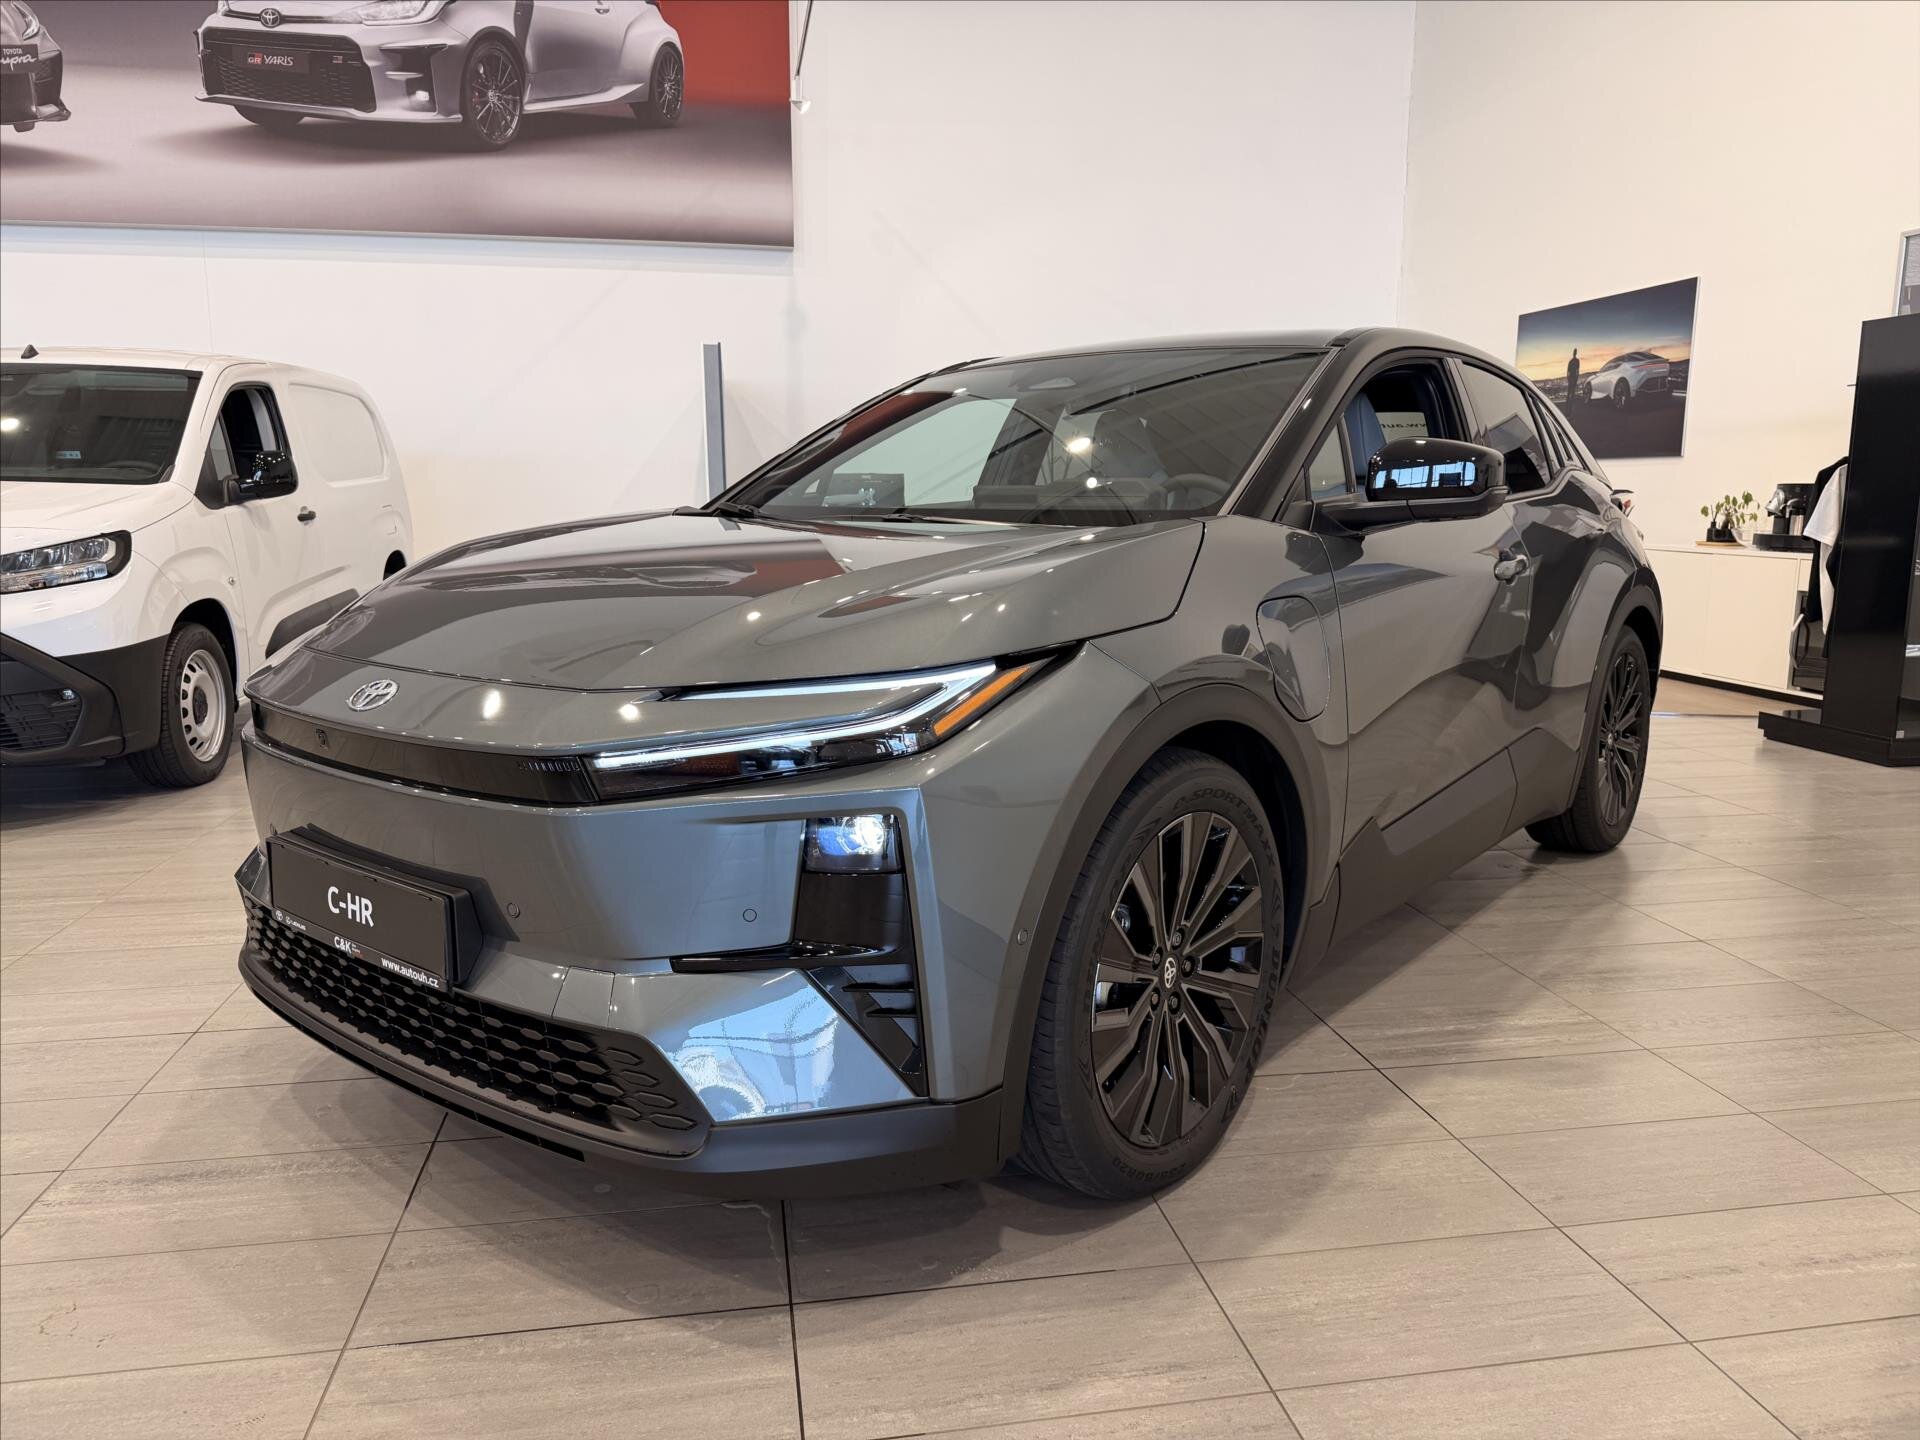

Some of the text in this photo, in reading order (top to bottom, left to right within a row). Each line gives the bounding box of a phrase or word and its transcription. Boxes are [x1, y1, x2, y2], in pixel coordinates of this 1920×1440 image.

[0, 54, 38, 71] upra
[263, 54, 294, 66] YARIS
[327, 886, 375, 928] C-HR
[334, 936, 352, 954] C&K
[381, 957, 439, 988] www.autouh.cz
